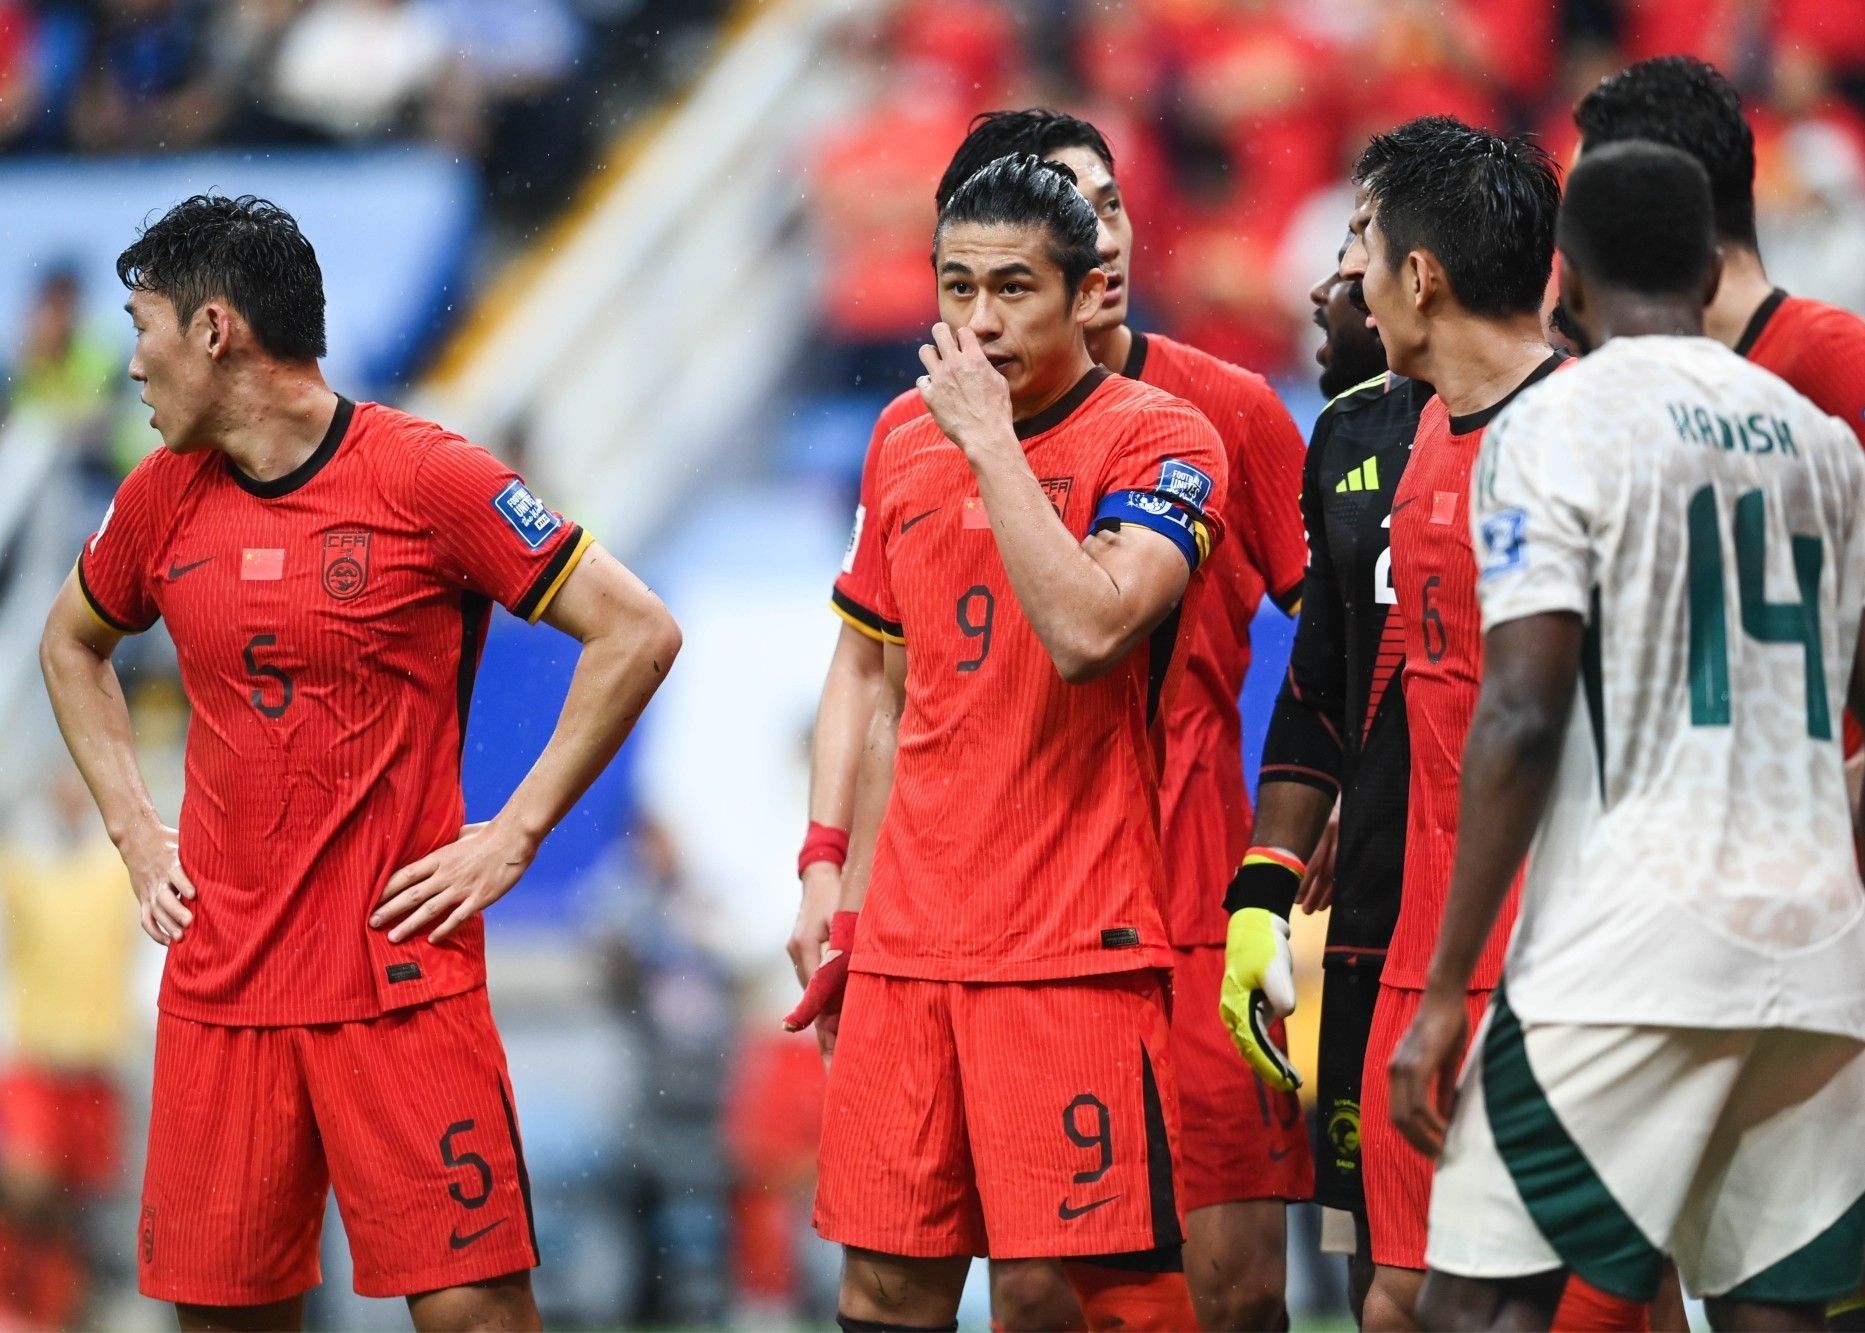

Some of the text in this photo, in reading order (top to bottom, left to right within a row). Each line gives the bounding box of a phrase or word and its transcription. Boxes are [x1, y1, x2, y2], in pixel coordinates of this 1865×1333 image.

[328, 535, 366, 548] CFA
[956, 584, 995, 672] 9
[1421, 575, 1448, 665] 6
[1687, 484, 1832, 741] 14
[242, 633, 294, 719] 5
[439, 1119, 493, 1210] 5
[1062, 1093, 1113, 1184] 9
